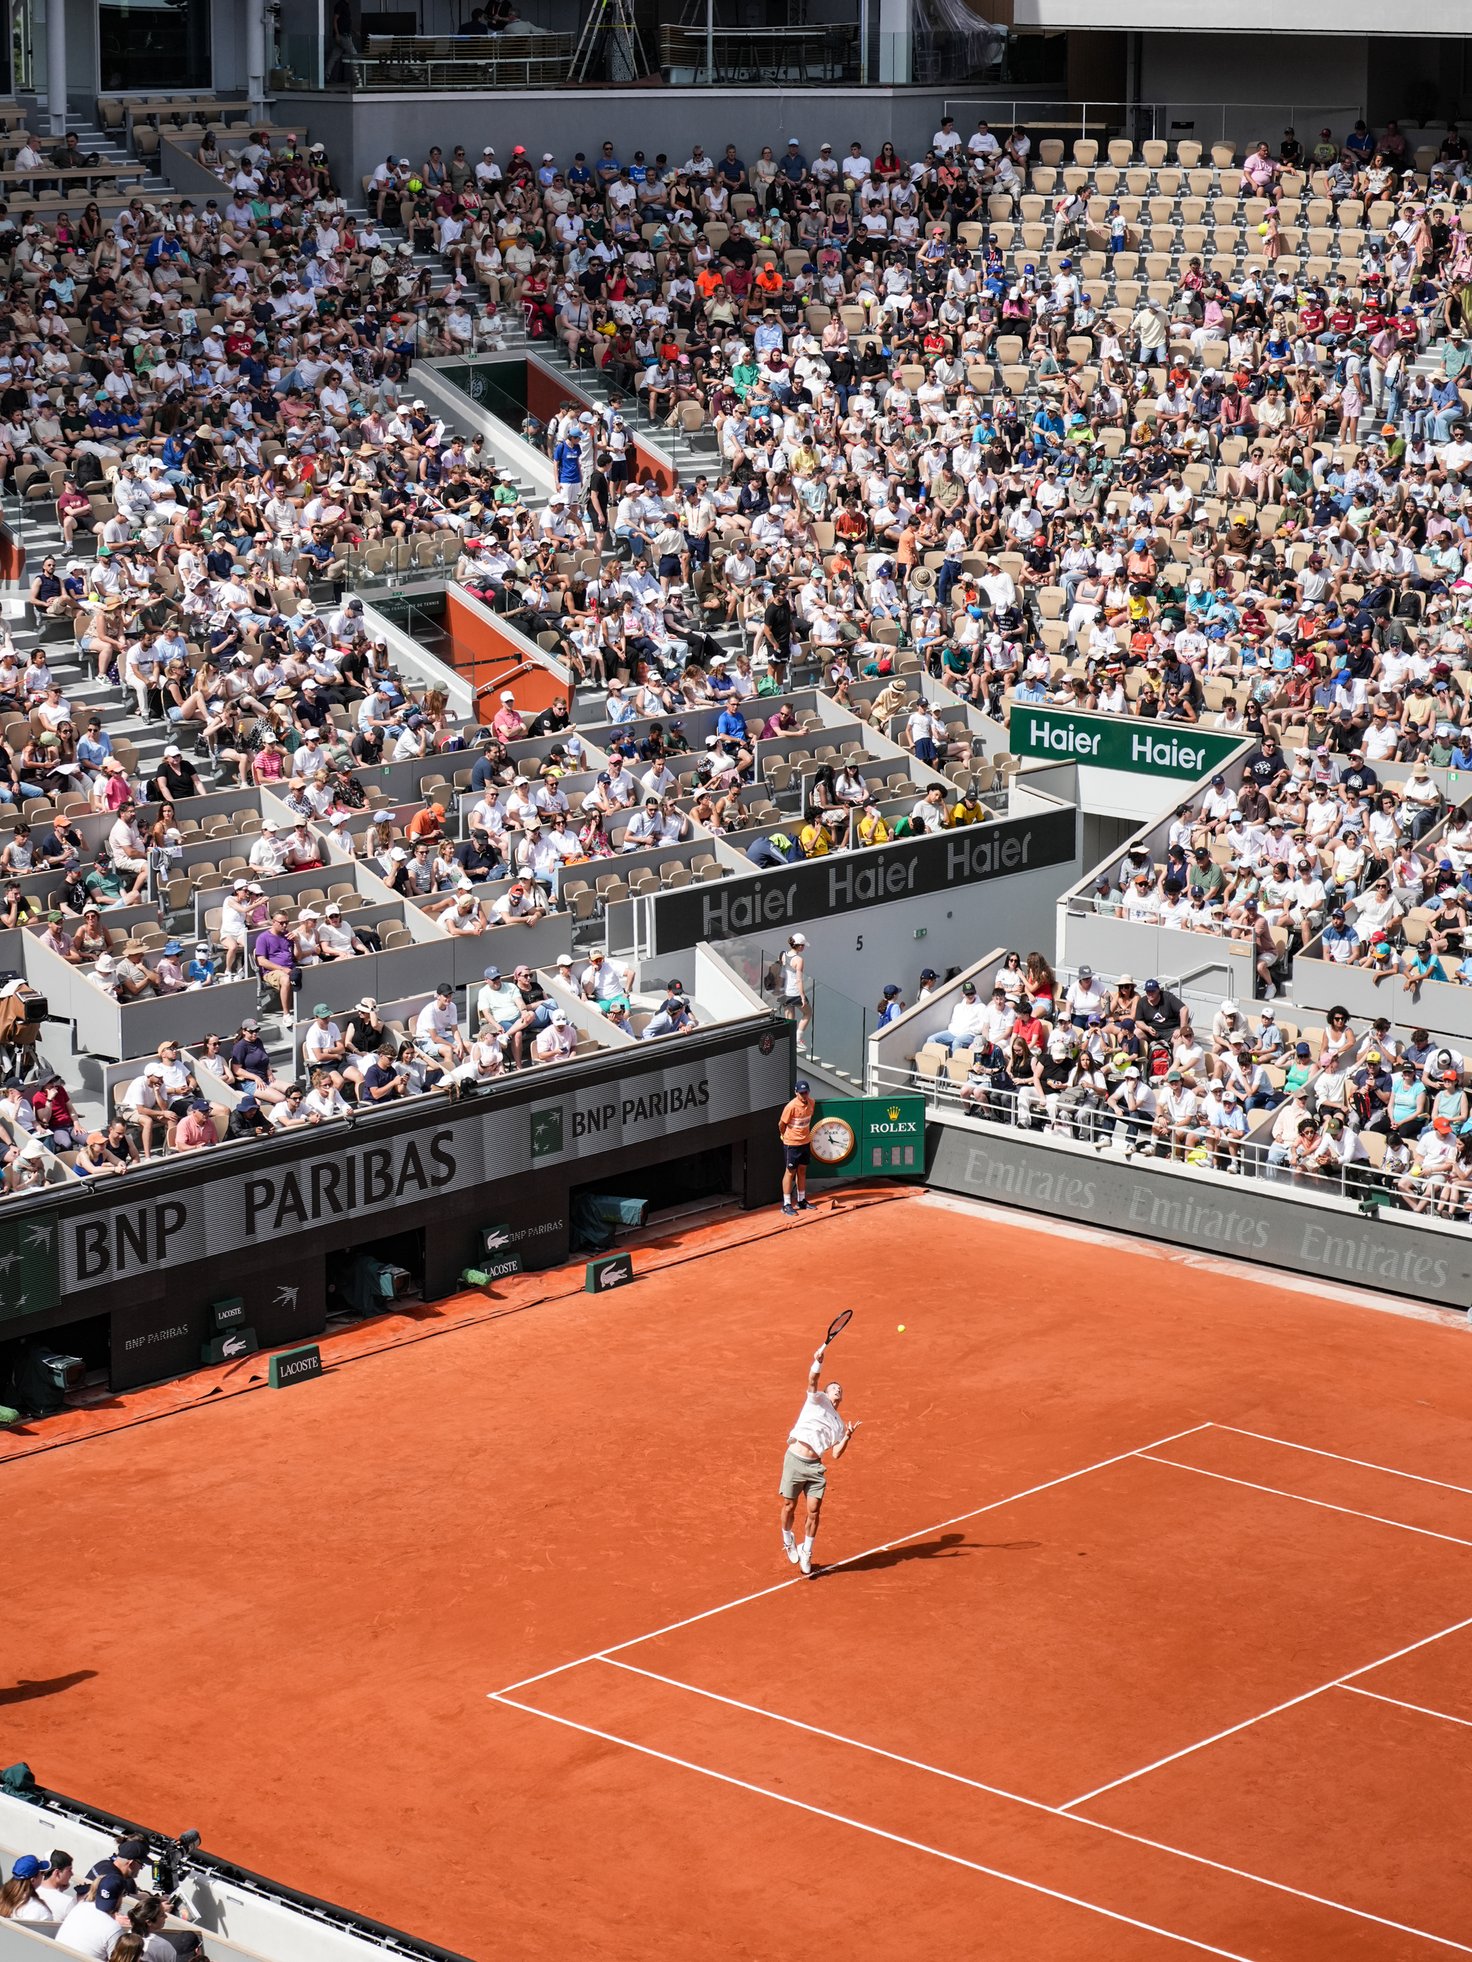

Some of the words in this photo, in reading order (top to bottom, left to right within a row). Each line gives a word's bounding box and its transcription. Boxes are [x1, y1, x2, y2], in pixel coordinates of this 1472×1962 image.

[1030, 719, 1101, 755] Haier
[1132, 734, 1205, 770] Haier
[703, 881, 797, 936] Haier
[829, 855, 918, 908] Haier
[947, 831, 1032, 880] Haier
[856, 935, 863, 951] 5
[572, 1103, 616, 1139] BNP
[622, 1079, 710, 1126] PARIBAS
[870, 1122, 916, 1133] ROLEX
[76, 1202, 187, 1280] BNP
[244, 1130, 457, 1236] PARIBAS
[528, 1219, 563, 1237] PARIBAS
[964, 1149, 1096, 1209] Emirates
[1128, 1185, 1270, 1248] Emirates
[1300, 1222, 1448, 1288] Emirates
[484, 1260, 518, 1277] LACOSTE
[218, 1307, 242, 1320] LACOSTE
[125, 1336, 145, 1350] BNP
[147, 1323, 189, 1343] PARIBAS
[280, 1356, 319, 1378] LACOSTE
